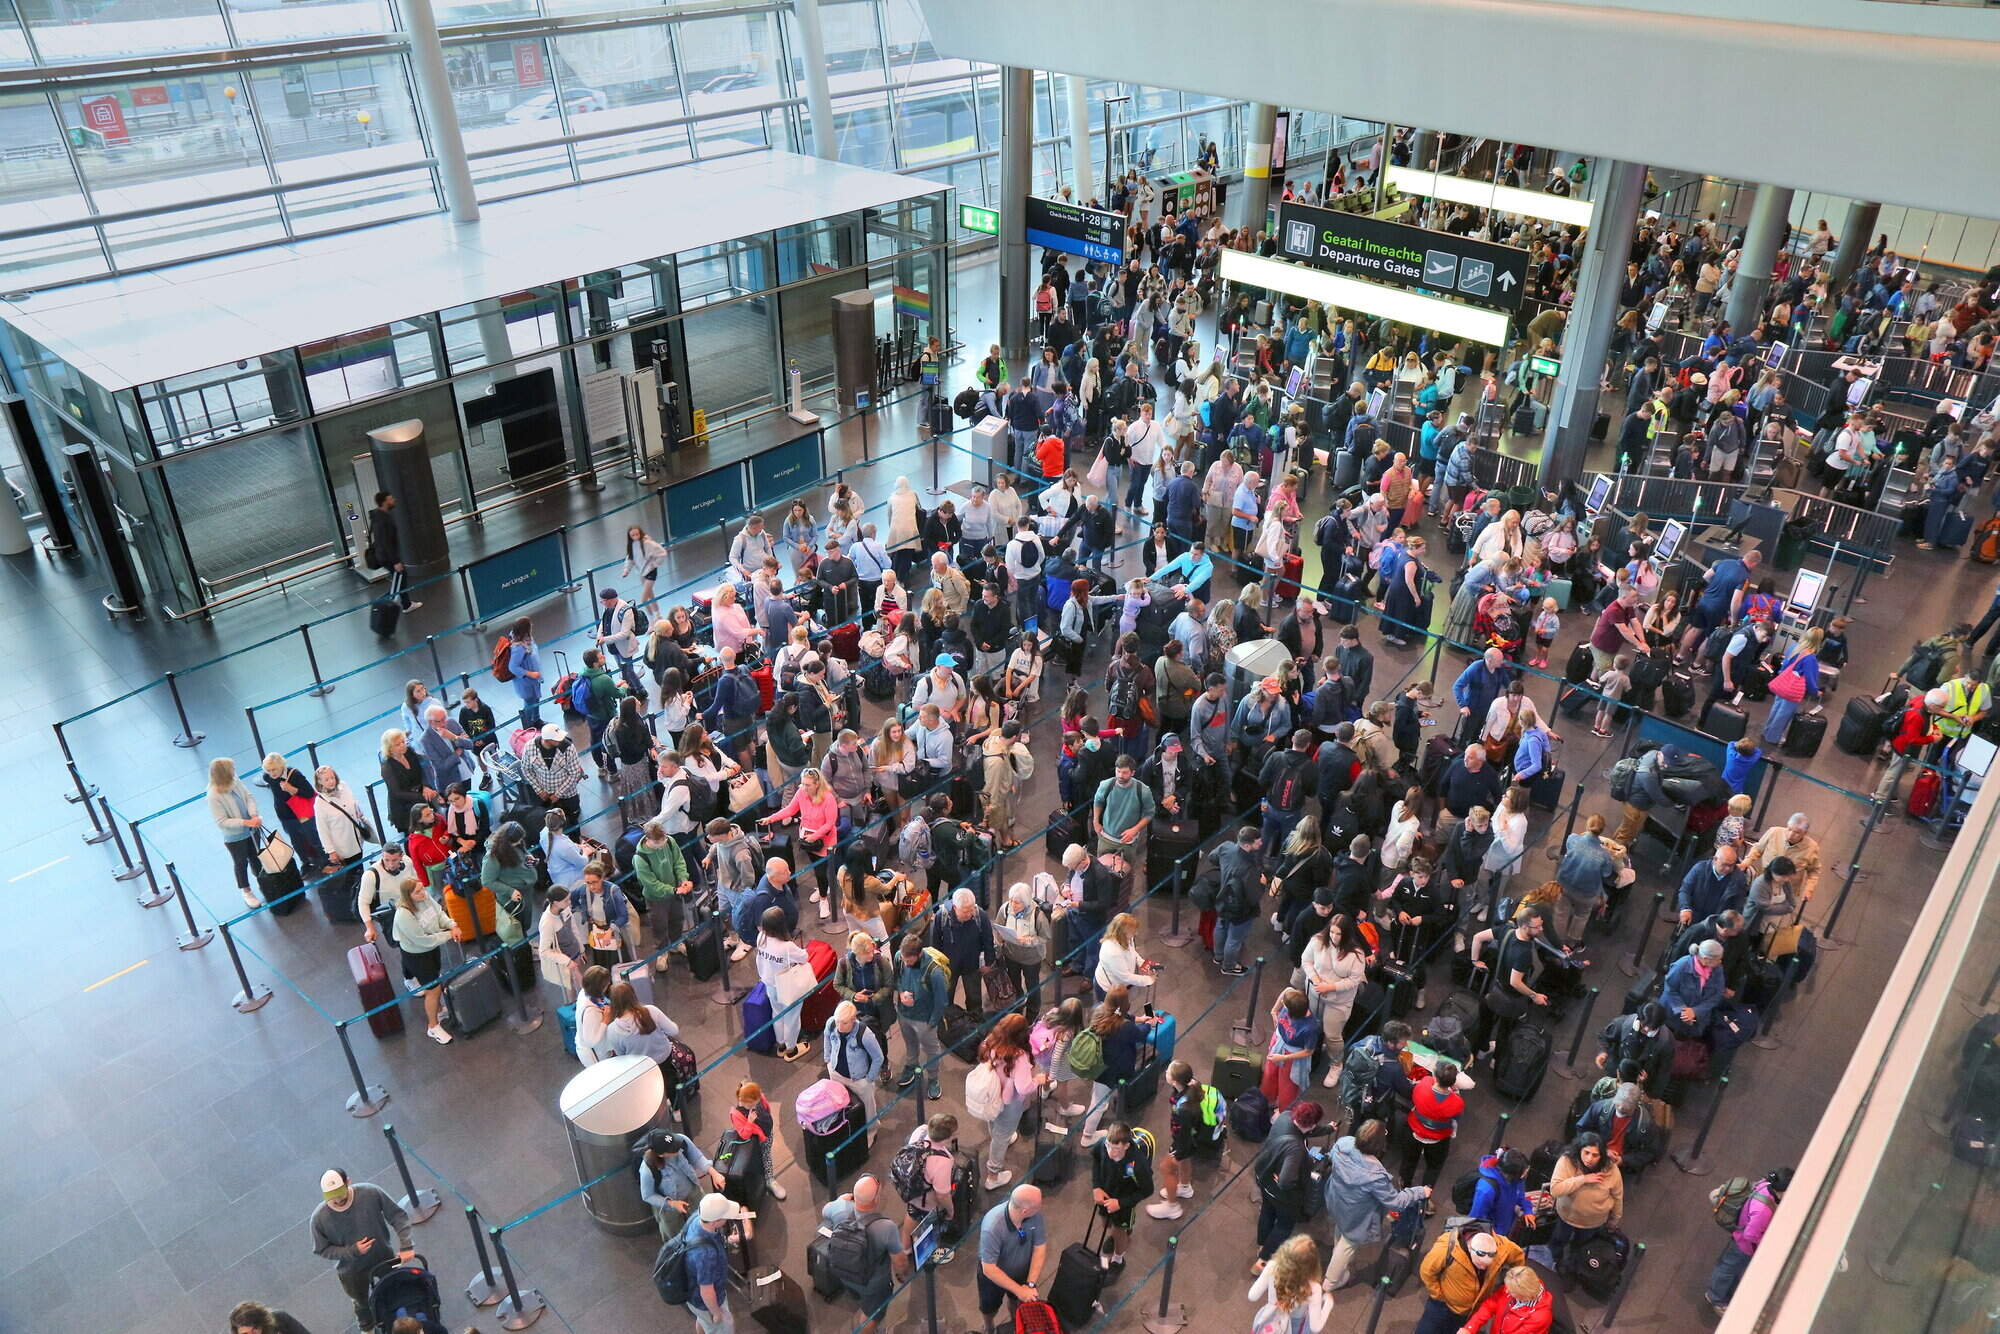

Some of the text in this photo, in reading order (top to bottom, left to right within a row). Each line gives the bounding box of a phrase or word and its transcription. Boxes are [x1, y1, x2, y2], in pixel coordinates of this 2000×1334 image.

[1319, 245, 1421, 279] Departure Gates
[1322, 230, 1423, 263] Geataí Imeachta
